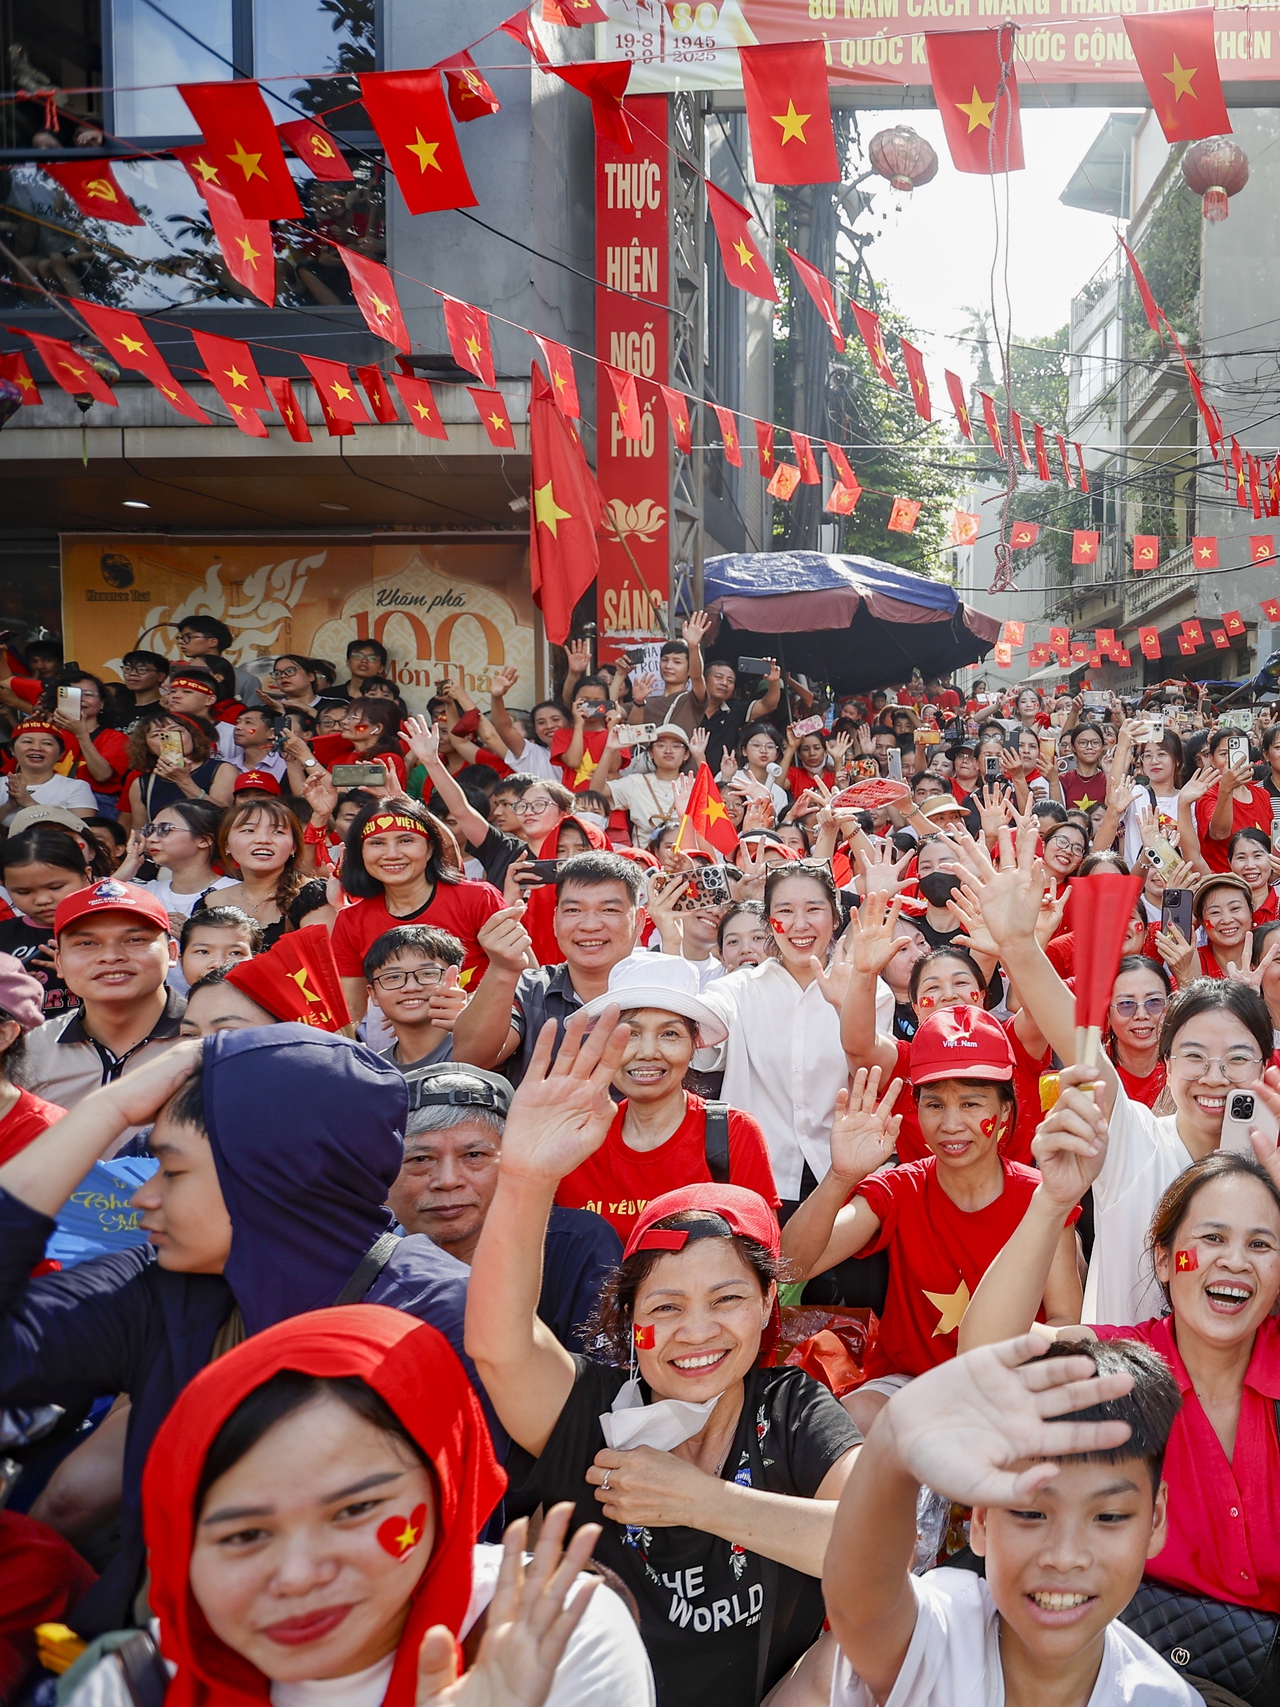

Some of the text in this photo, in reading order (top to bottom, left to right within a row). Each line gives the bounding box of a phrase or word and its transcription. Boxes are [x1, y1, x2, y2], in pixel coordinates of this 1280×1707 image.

[672, 2, 718, 32] 80
[615, 33, 653, 49] 19-8
[672, 36, 716, 49] 1945
[841, 27, 903, 68] QUỐC
[672, 51, 717, 63] 2025
[604, 158, 661, 219] THỰC
[606, 236, 658, 301] HIỆN
[610, 321, 656, 378] NGÕ
[376, 587, 467, 613] Khám phá
[350, 610, 505, 665] 100
[395, 816, 415, 831] VIỆT
[961, 1040, 978, 1048] Nam
[608, 1199, 636, 1215] YÊU
[669, 1583, 765, 1633] WORLD
